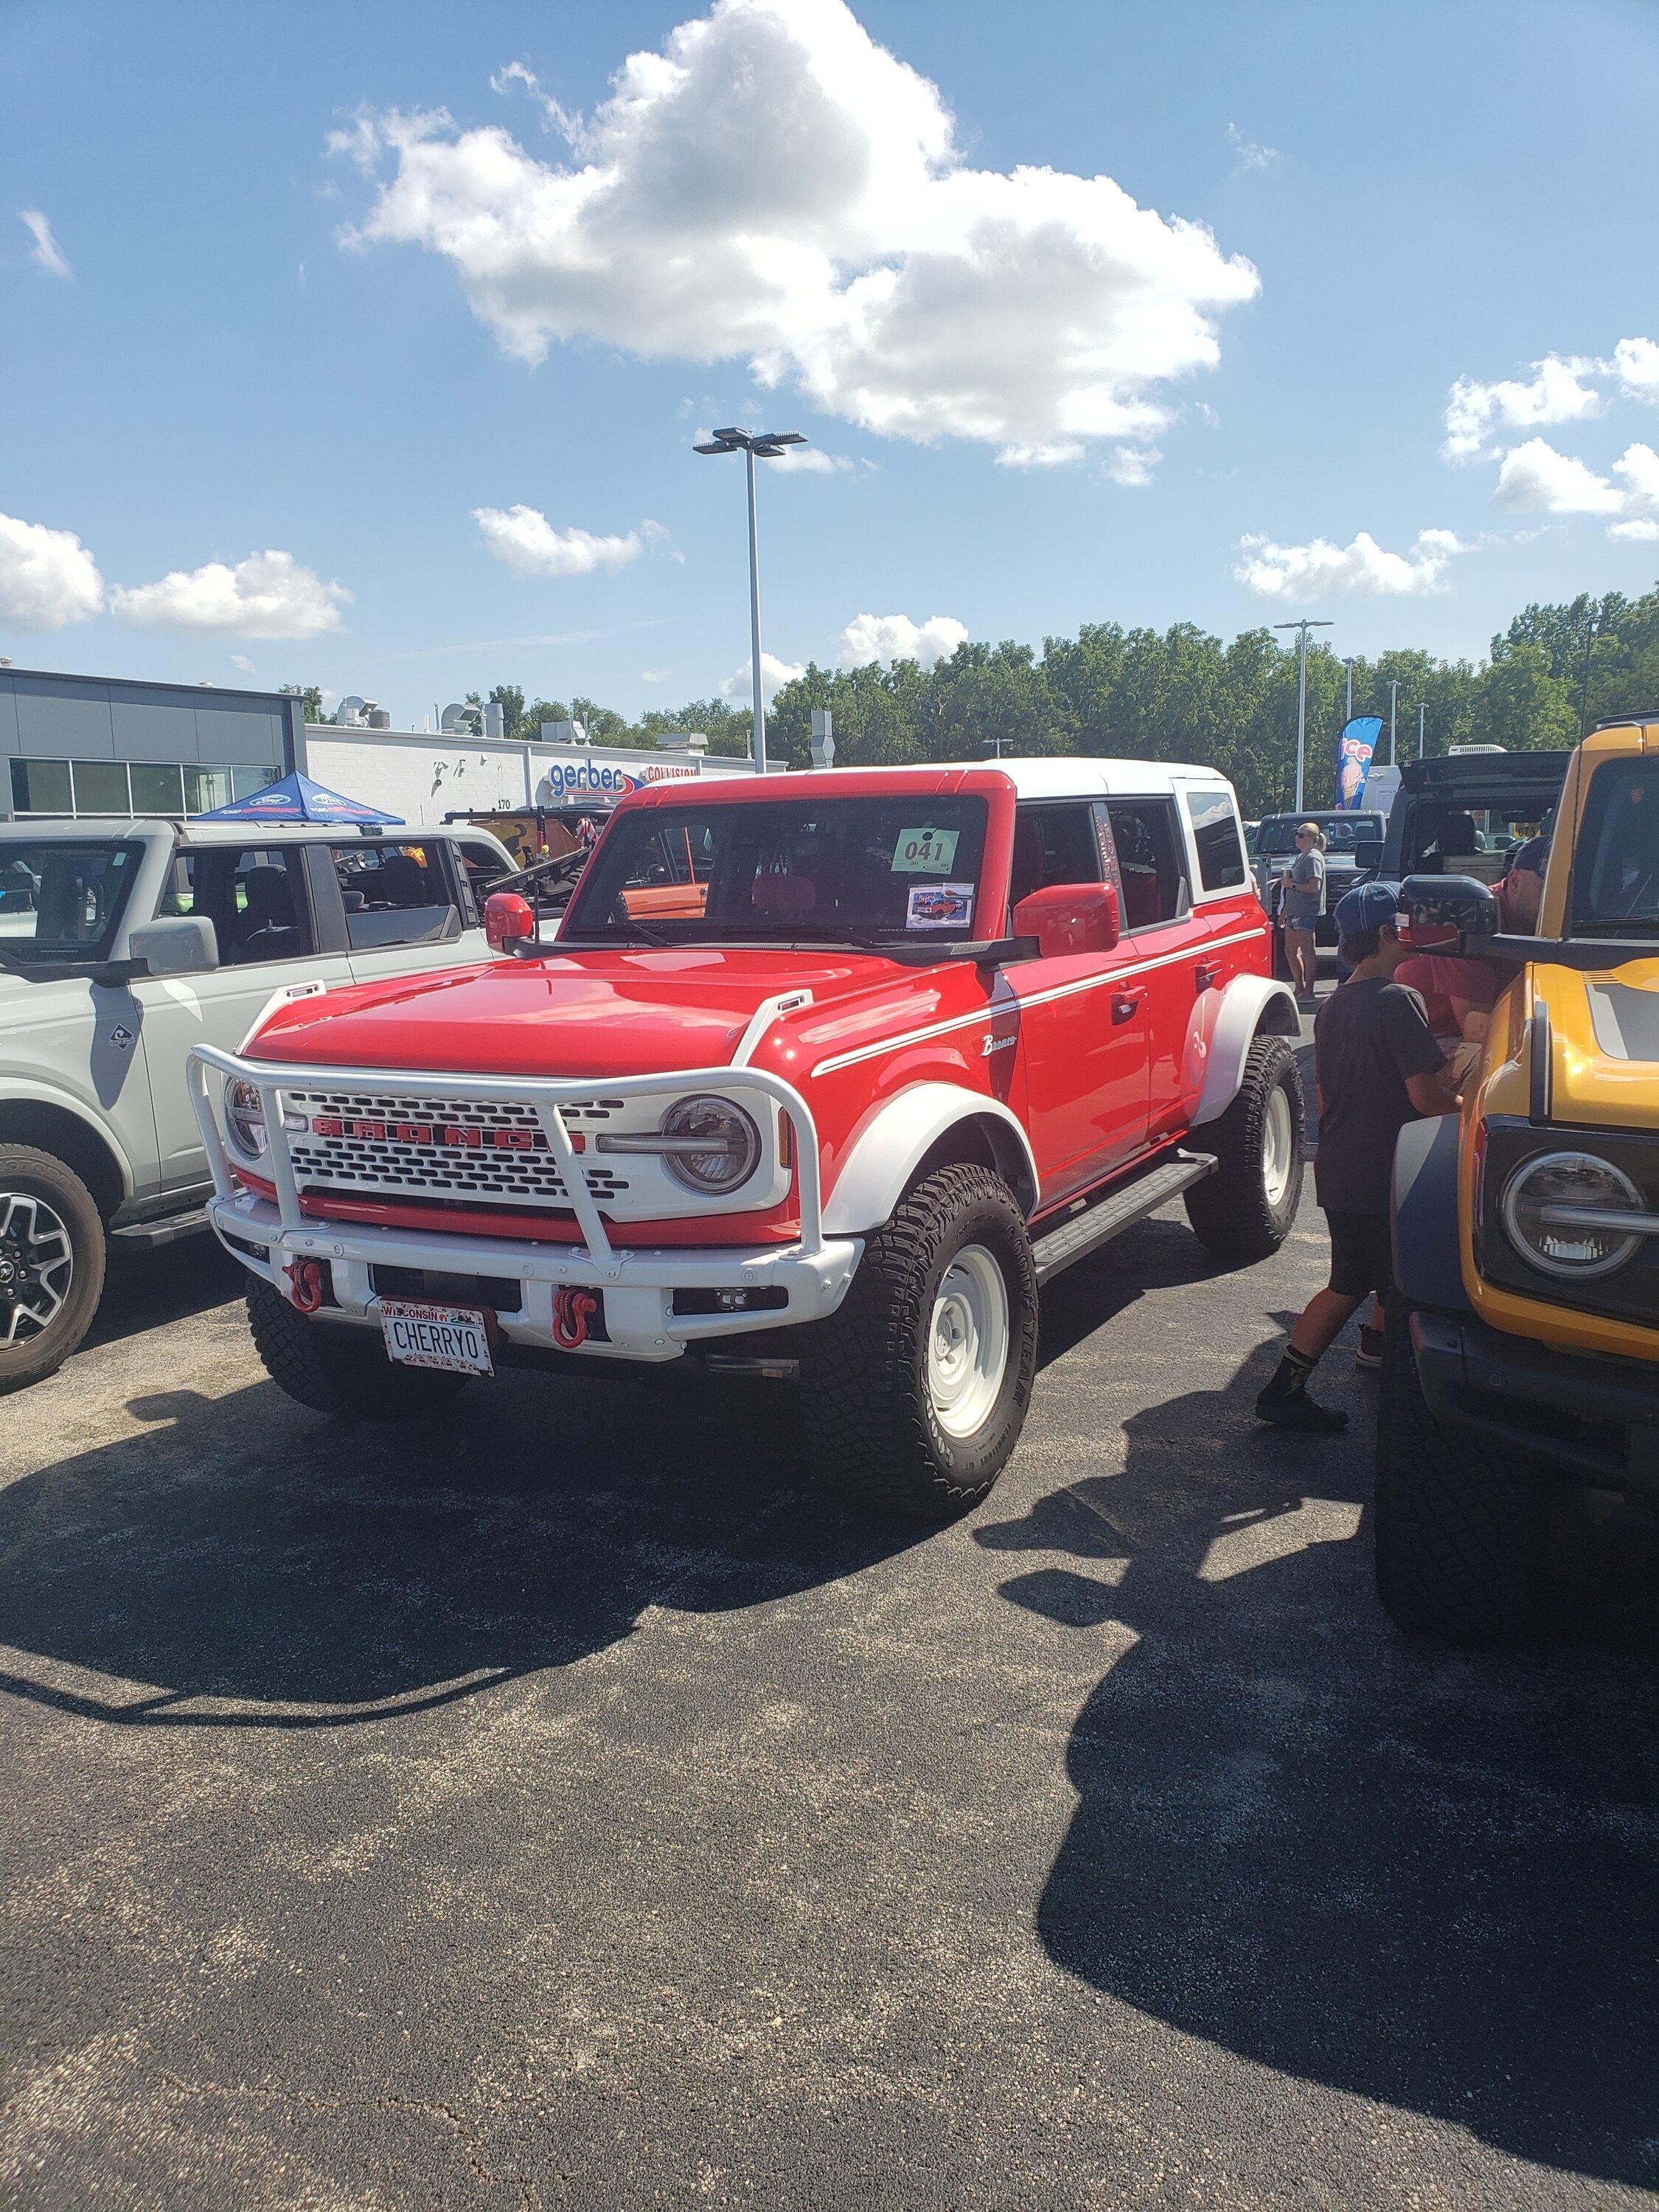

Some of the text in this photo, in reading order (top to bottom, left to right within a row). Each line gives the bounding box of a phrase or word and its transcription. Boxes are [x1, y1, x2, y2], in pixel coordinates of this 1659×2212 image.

[550, 759, 622, 797] gerber
[498, 799, 510, 810] 170
[904, 841, 944, 861] 041
[981, 1034, 1017, 1056] Bronco
[394, 1321, 479, 1359] CHERRYO
